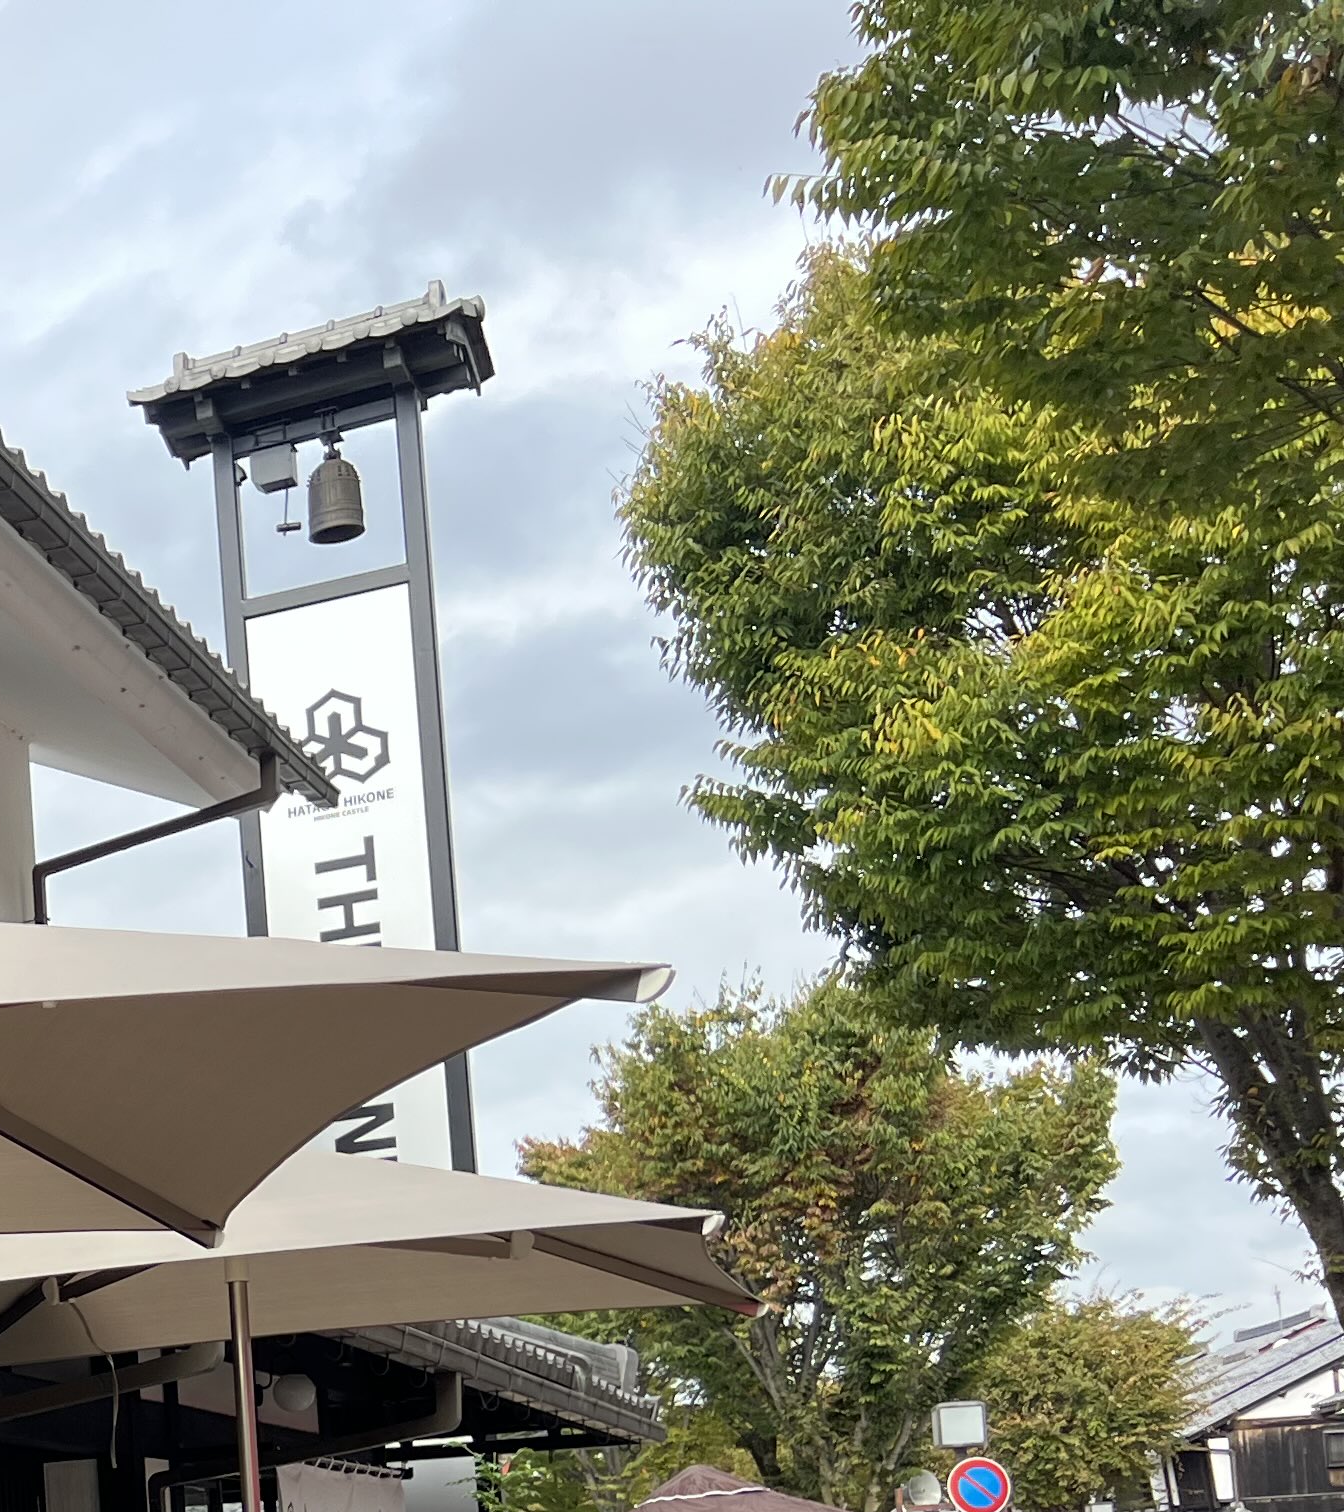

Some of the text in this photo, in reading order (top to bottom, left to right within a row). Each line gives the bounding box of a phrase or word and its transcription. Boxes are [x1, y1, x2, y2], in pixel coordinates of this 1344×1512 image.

[343, 788, 394, 807] HIKONE
[342, 806, 370, 817] CASTLE
[315, 835, 382, 947] TH
